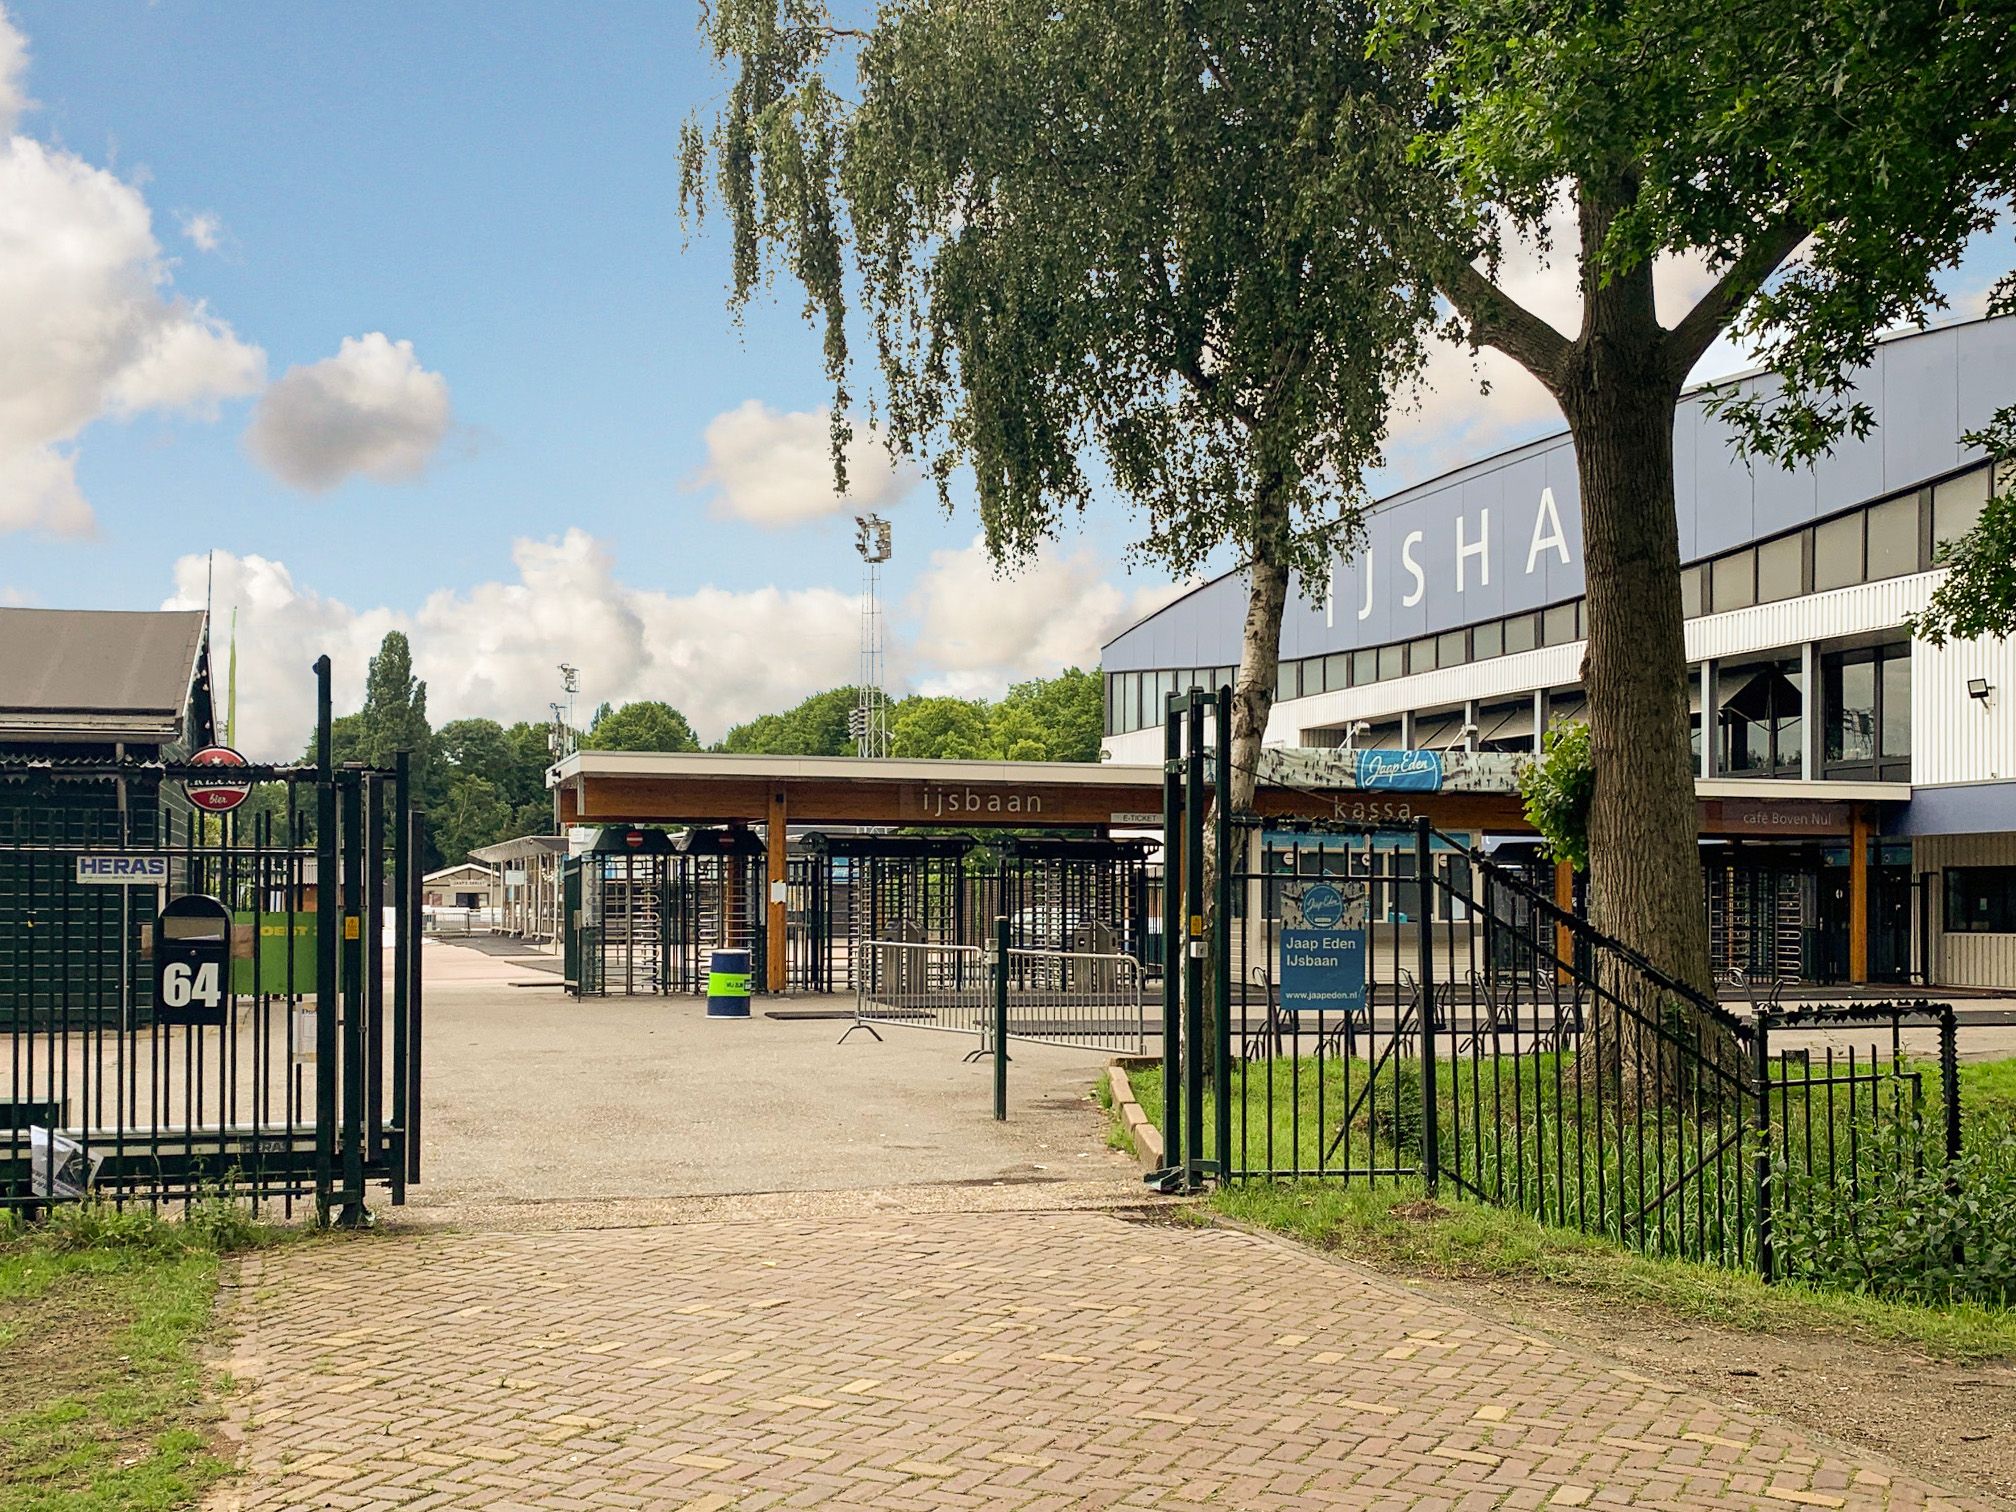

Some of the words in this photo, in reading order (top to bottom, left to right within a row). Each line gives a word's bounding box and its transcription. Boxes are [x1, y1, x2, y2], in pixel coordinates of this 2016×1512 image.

[1365, 755, 1399, 786] Jaap
[1400, 751, 1429, 772] Eden
[209, 793, 228, 804] bier
[923, 787, 1041, 817] ijsbaan
[1334, 795, 1411, 820] kassa
[1123, 814, 1156, 822] E-TICKET
[1772, 812, 1808, 825] Boven
[1811, 813, 1832, 826] Nul
[80, 858, 165, 874] HERAS
[1286, 937, 1319, 951] Jaap
[1322, 938, 1356, 949] Eden
[1286, 954, 1338, 966] IJsbaan
[163, 962, 221, 1008] 64
